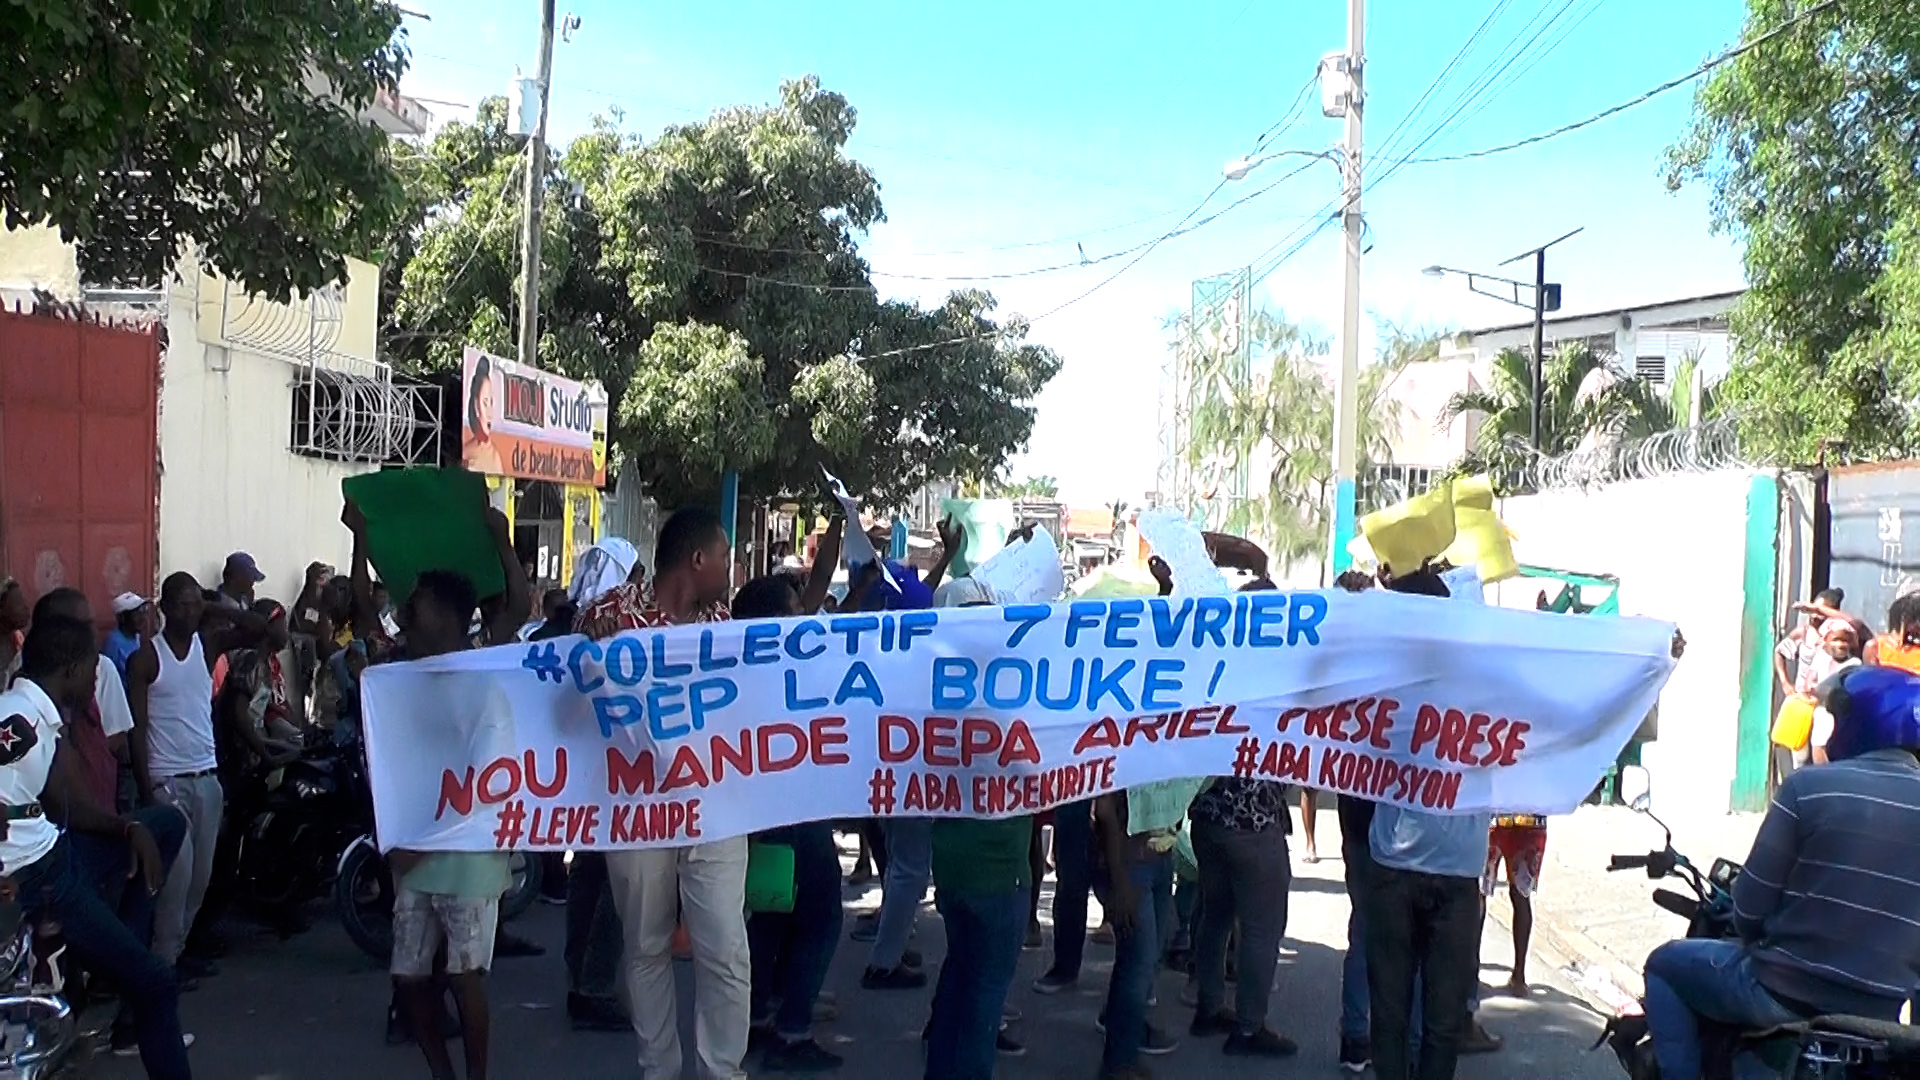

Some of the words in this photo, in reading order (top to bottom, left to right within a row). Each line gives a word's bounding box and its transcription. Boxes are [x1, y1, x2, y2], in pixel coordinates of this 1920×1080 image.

[550, 386, 592, 433] Studio
[512, 440, 526, 471] de
[522, 611, 938, 694] #COLLECTIF
[1003, 605, 1052, 649] 7
[1064, 593, 1328, 649] FEVRIER
[785, 661, 883, 711] LA
[932, 657, 1186, 711] BOUKE
[434, 746, 567, 821] NOU
[606, 717, 850, 795] MANDE
[877, 714, 1041, 767] DEPA
[1073, 704, 1250, 754] ARIEL
[1278, 697, 1400, 750] PRESE
[1410, 704, 1531, 767] PRESE
[868, 769, 962, 814] #ABA
[973, 756, 1117, 814] ENSEKIRITE
[1232, 737, 1311, 779] #ABA
[1319, 750, 1462, 810] KORIPSYON
[494, 799, 600, 848] #LEVE
[610, 799, 701, 842] KANPE
